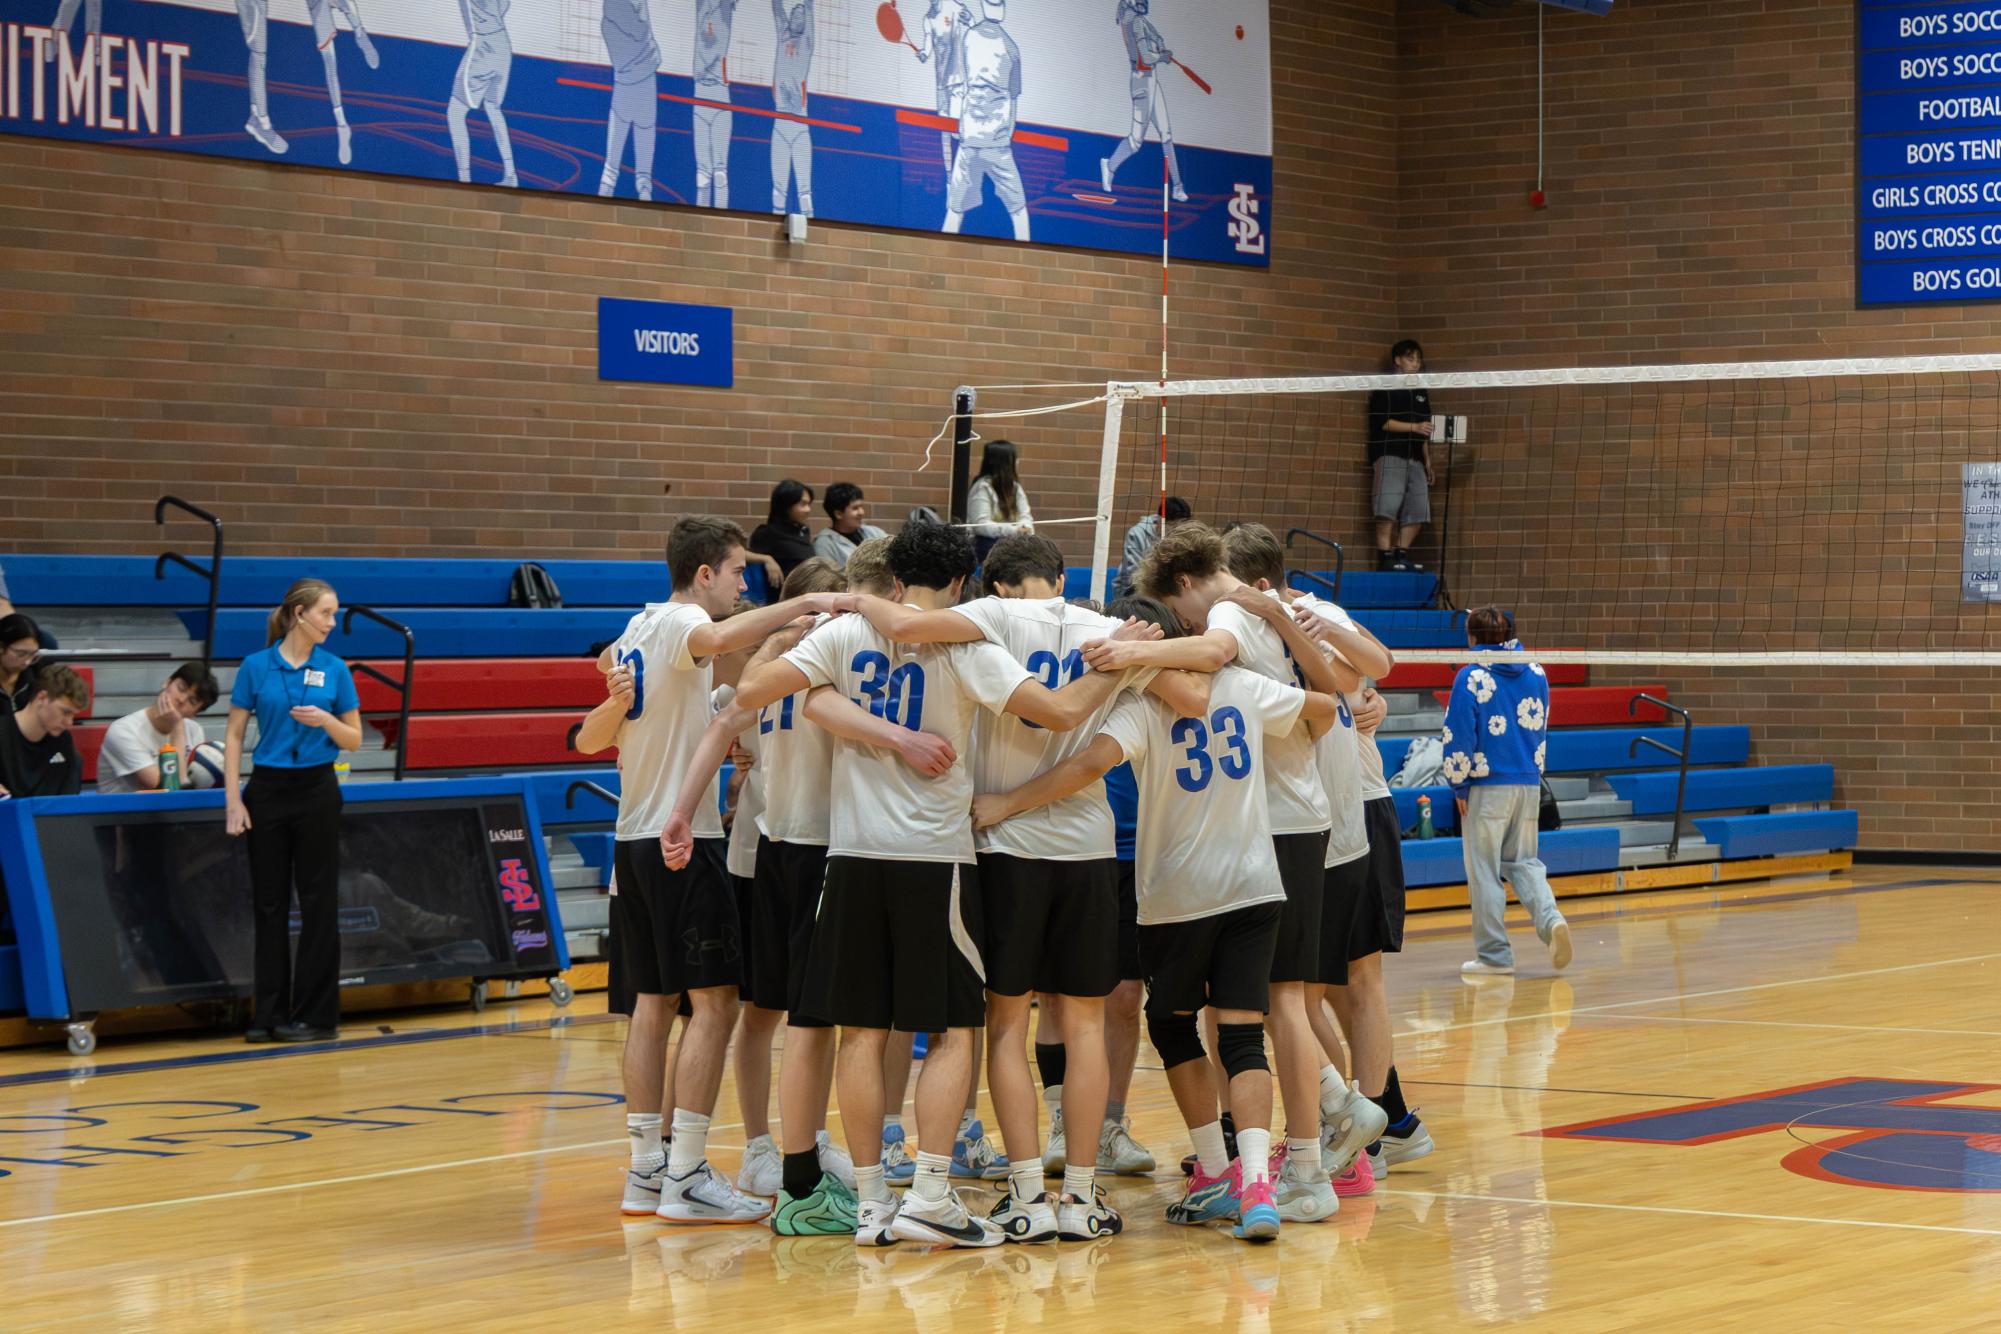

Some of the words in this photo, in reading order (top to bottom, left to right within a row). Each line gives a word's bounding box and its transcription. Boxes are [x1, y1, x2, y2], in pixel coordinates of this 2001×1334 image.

[1900, 14, 1948, 38] BOYS
[1952, 9, 2001, 33] SOCC
[0, 21, 191, 138] ITMENT
[1900, 56, 1949, 80] BOYS
[1953, 52, 2001, 76] SOCC
[1906, 141, 1955, 164] BOYS
[1872, 186, 1920, 209] GIRLS
[1923, 182, 1979, 206] CROSS
[1873, 229, 1918, 251] BOYS
[1921, 225, 1977, 249] CROSS
[1912, 269, 1961, 292] BOYS
[633, 328, 701, 356] VISITORS
[1964, 505, 2001, 515] SUPPO
[850, 649, 925, 732] 30
[1170, 705, 1252, 793] 33
[163, 759, 177, 774] G
